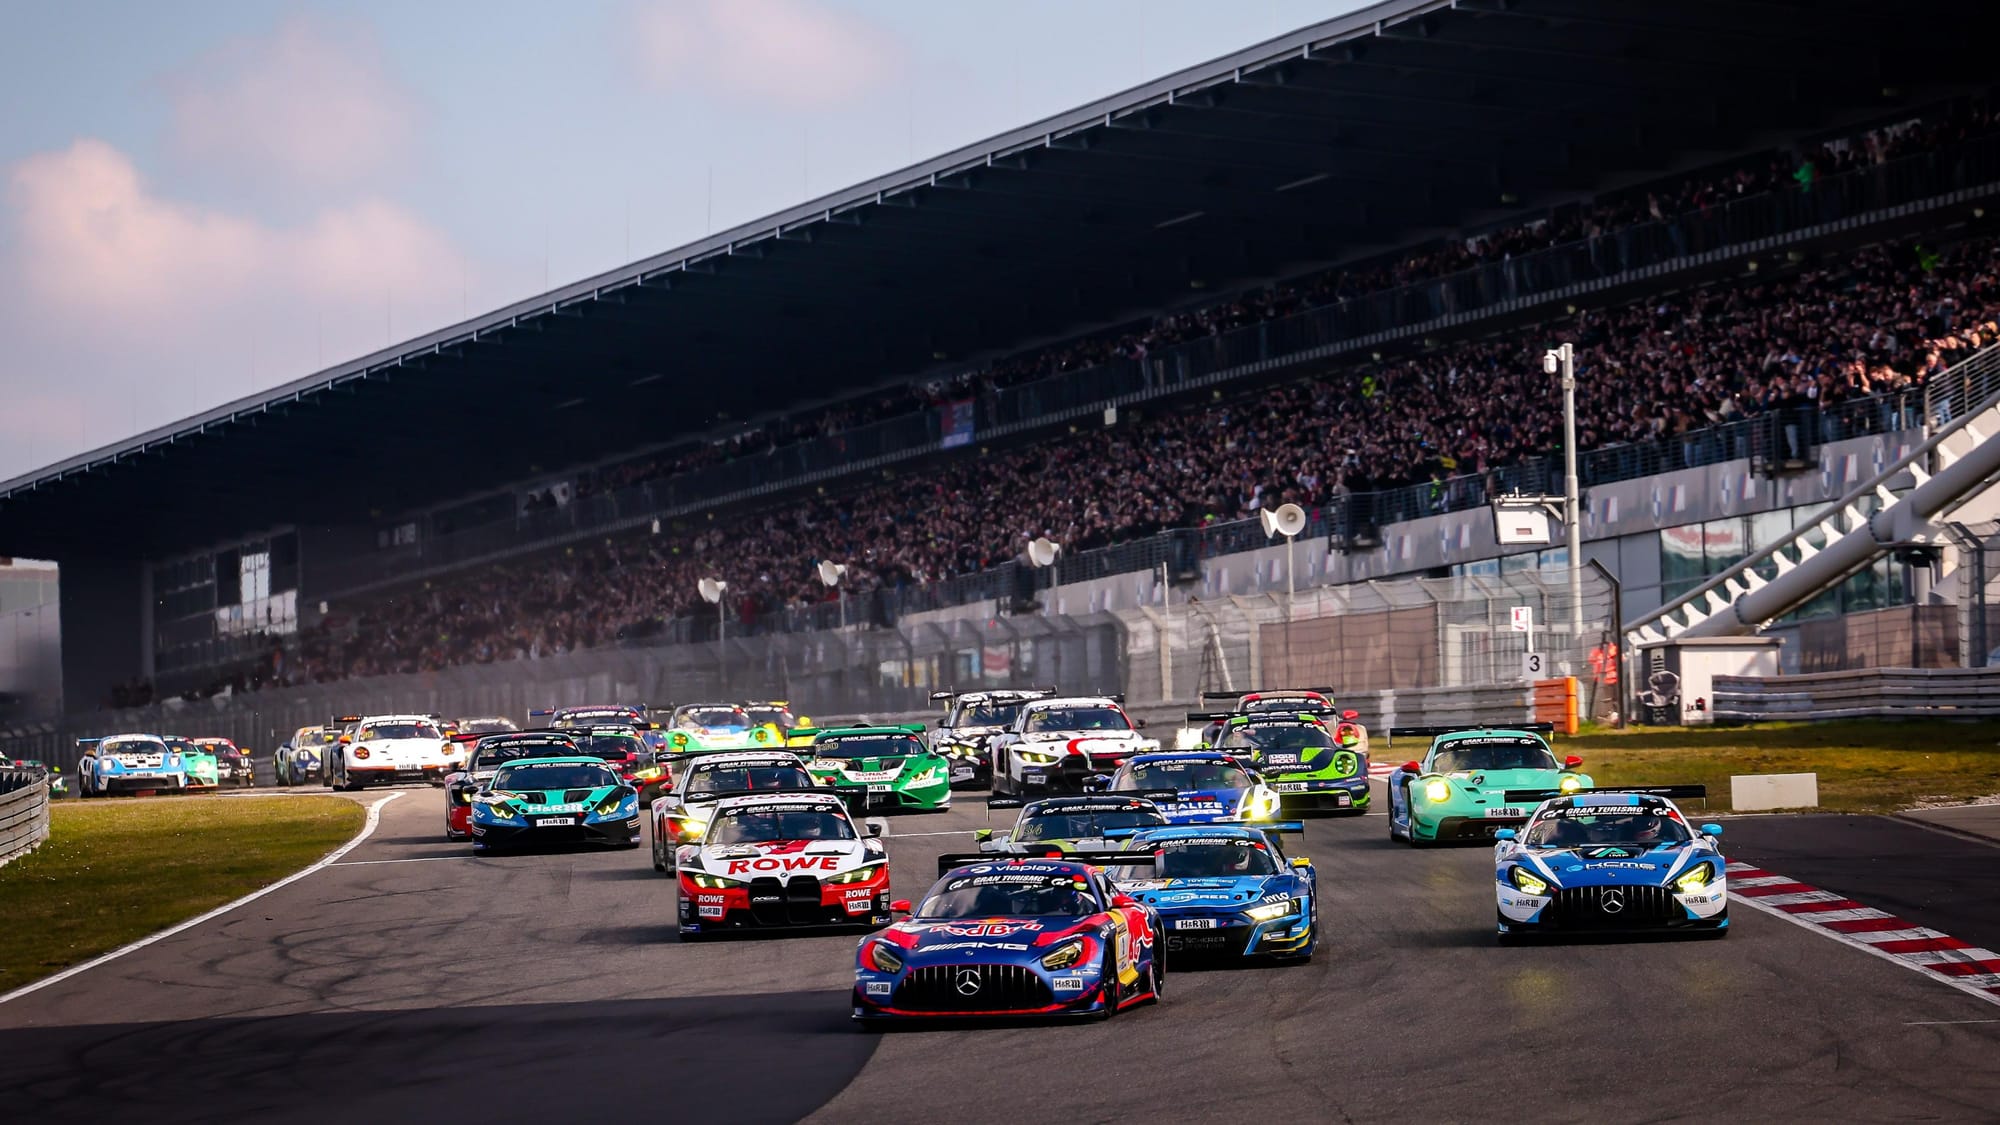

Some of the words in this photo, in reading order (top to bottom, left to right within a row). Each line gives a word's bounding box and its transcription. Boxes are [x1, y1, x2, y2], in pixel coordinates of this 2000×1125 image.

[1529, 655, 1540, 672] 3
[1158, 802, 1223, 811] REALIZE
[1566, 807, 1595, 815] GRAN
[1160, 840, 1185, 848] GRAN
[728, 857, 839, 874] ROWE
[973, 876, 999, 884] GRAN
[846, 889, 871, 898] ROWE
[1160, 893, 1229, 902] SCHERER
[1262, 891, 1290, 904] HYLO
[698, 894, 724, 903] ROWE
[1516, 899, 1531, 907] H&R
[1685, 896, 1699, 905] H&R
[1181, 920, 1199, 928] H&R
[954, 942, 1029, 951] AMG
[867, 983, 882, 993] H&R
[1054, 980, 1072, 989] H&R
